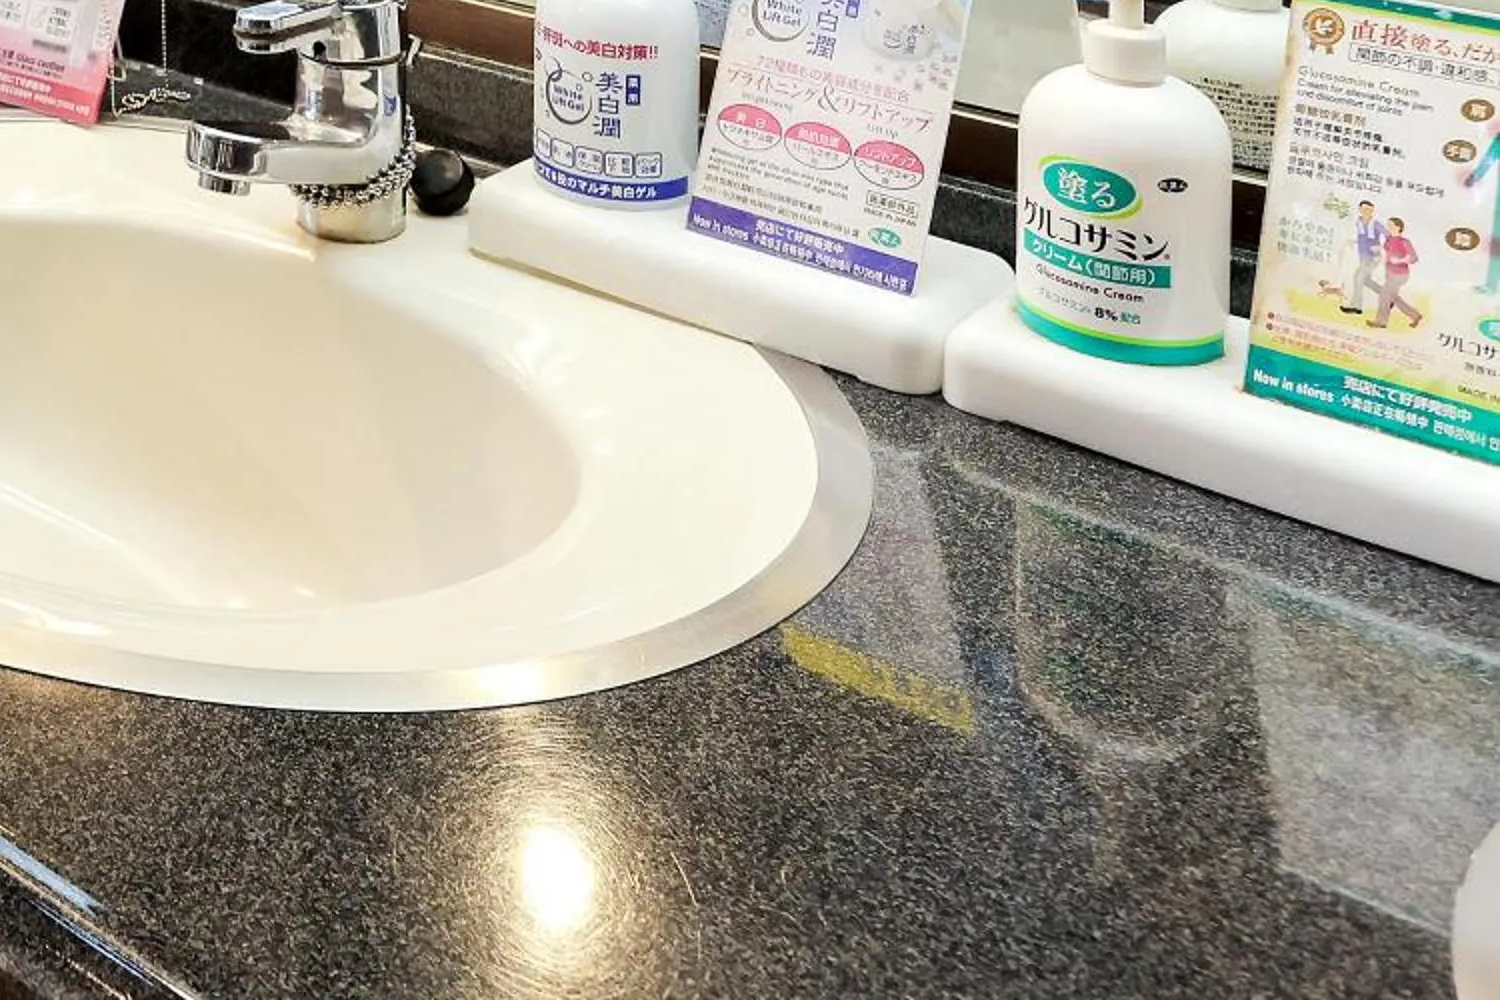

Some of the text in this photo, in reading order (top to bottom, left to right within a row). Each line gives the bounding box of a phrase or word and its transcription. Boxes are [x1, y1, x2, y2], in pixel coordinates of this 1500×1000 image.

[553, 84, 583, 101] White
[1057, 167, 1116, 209] 塗る
[1023, 196, 1169, 261] グルコサミン
[1035, 264, 1145, 303] Glucosamine Cream
[1094, 306, 1119, 322] 8%
[1252, 368, 1335, 403] Now in stores
